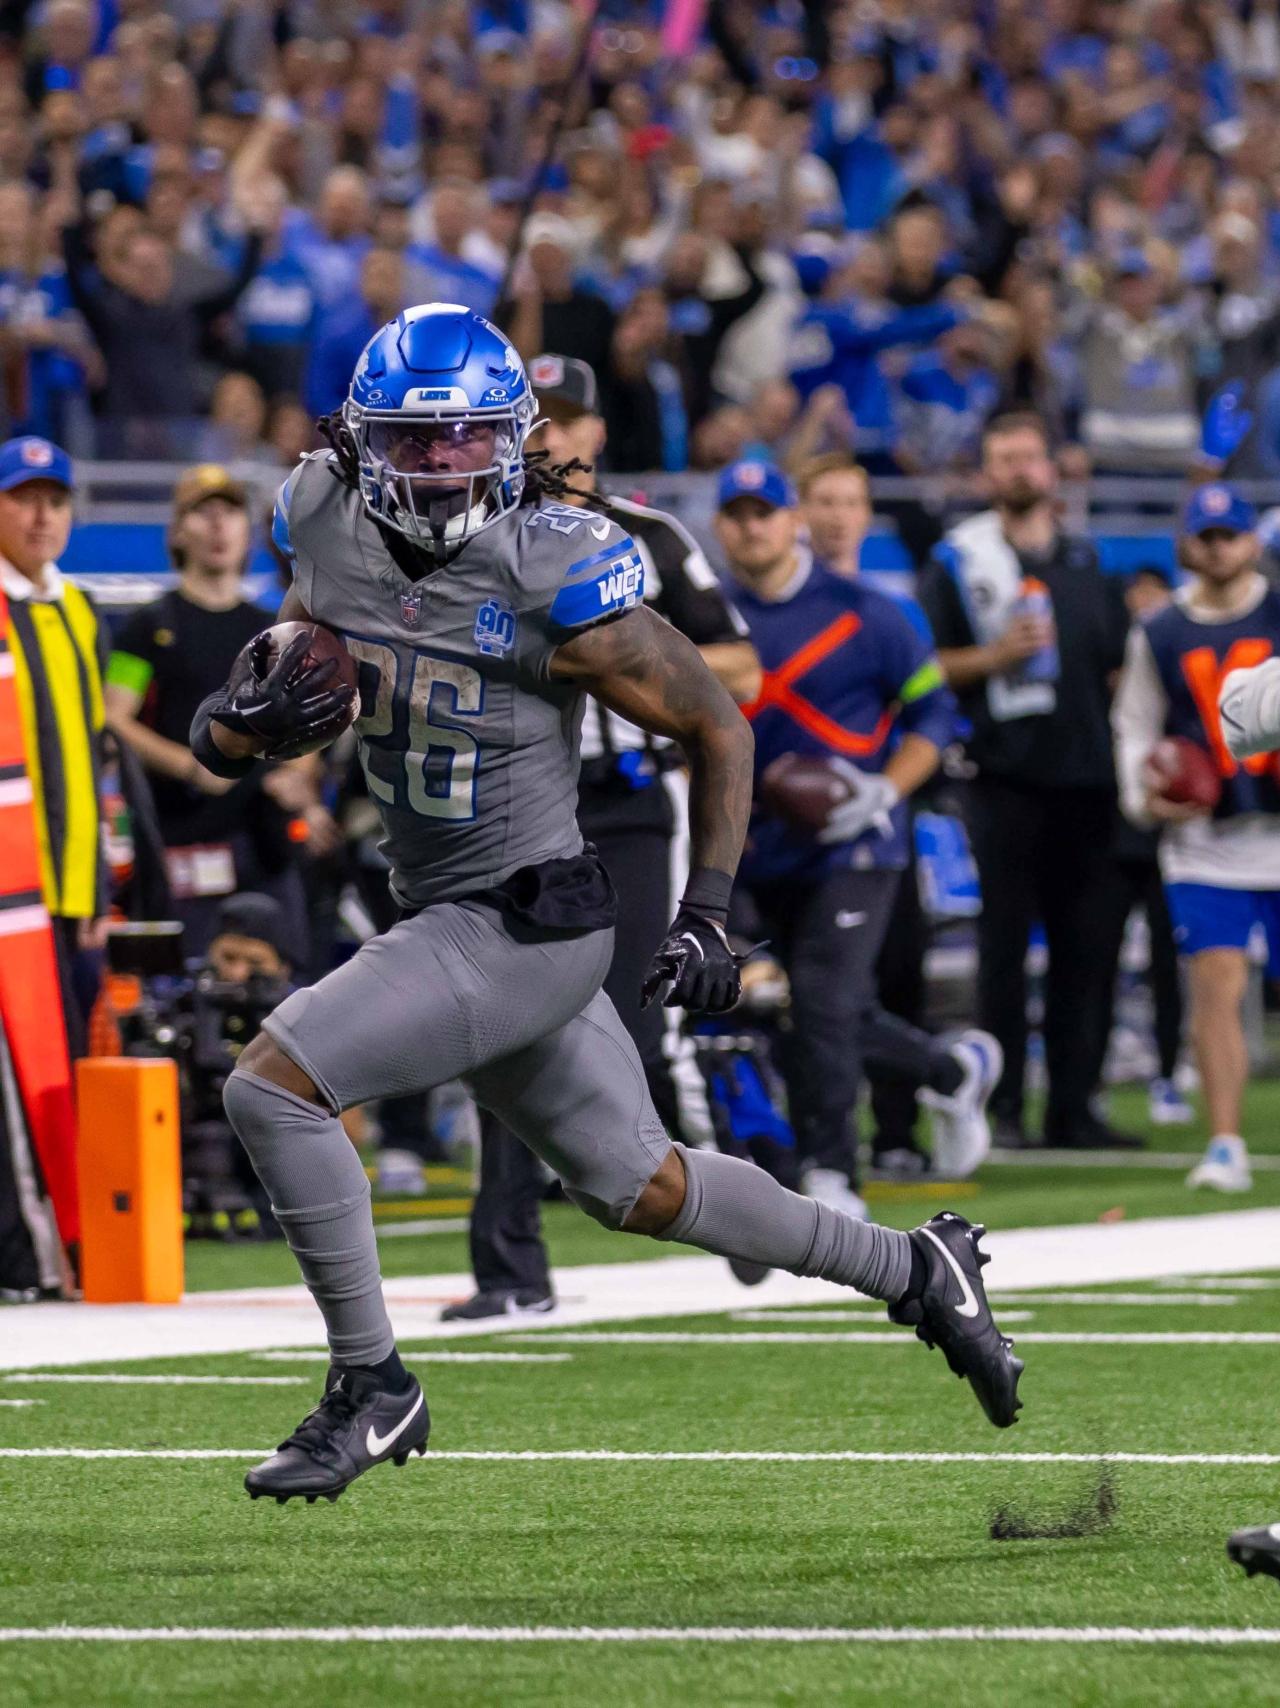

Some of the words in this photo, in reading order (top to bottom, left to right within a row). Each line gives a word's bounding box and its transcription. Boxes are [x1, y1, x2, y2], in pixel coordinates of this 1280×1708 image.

[524, 504, 602, 537] 26
[597, 561, 644, 607] WCF
[478, 606, 516, 645] 90
[342, 630, 485, 824] 26
